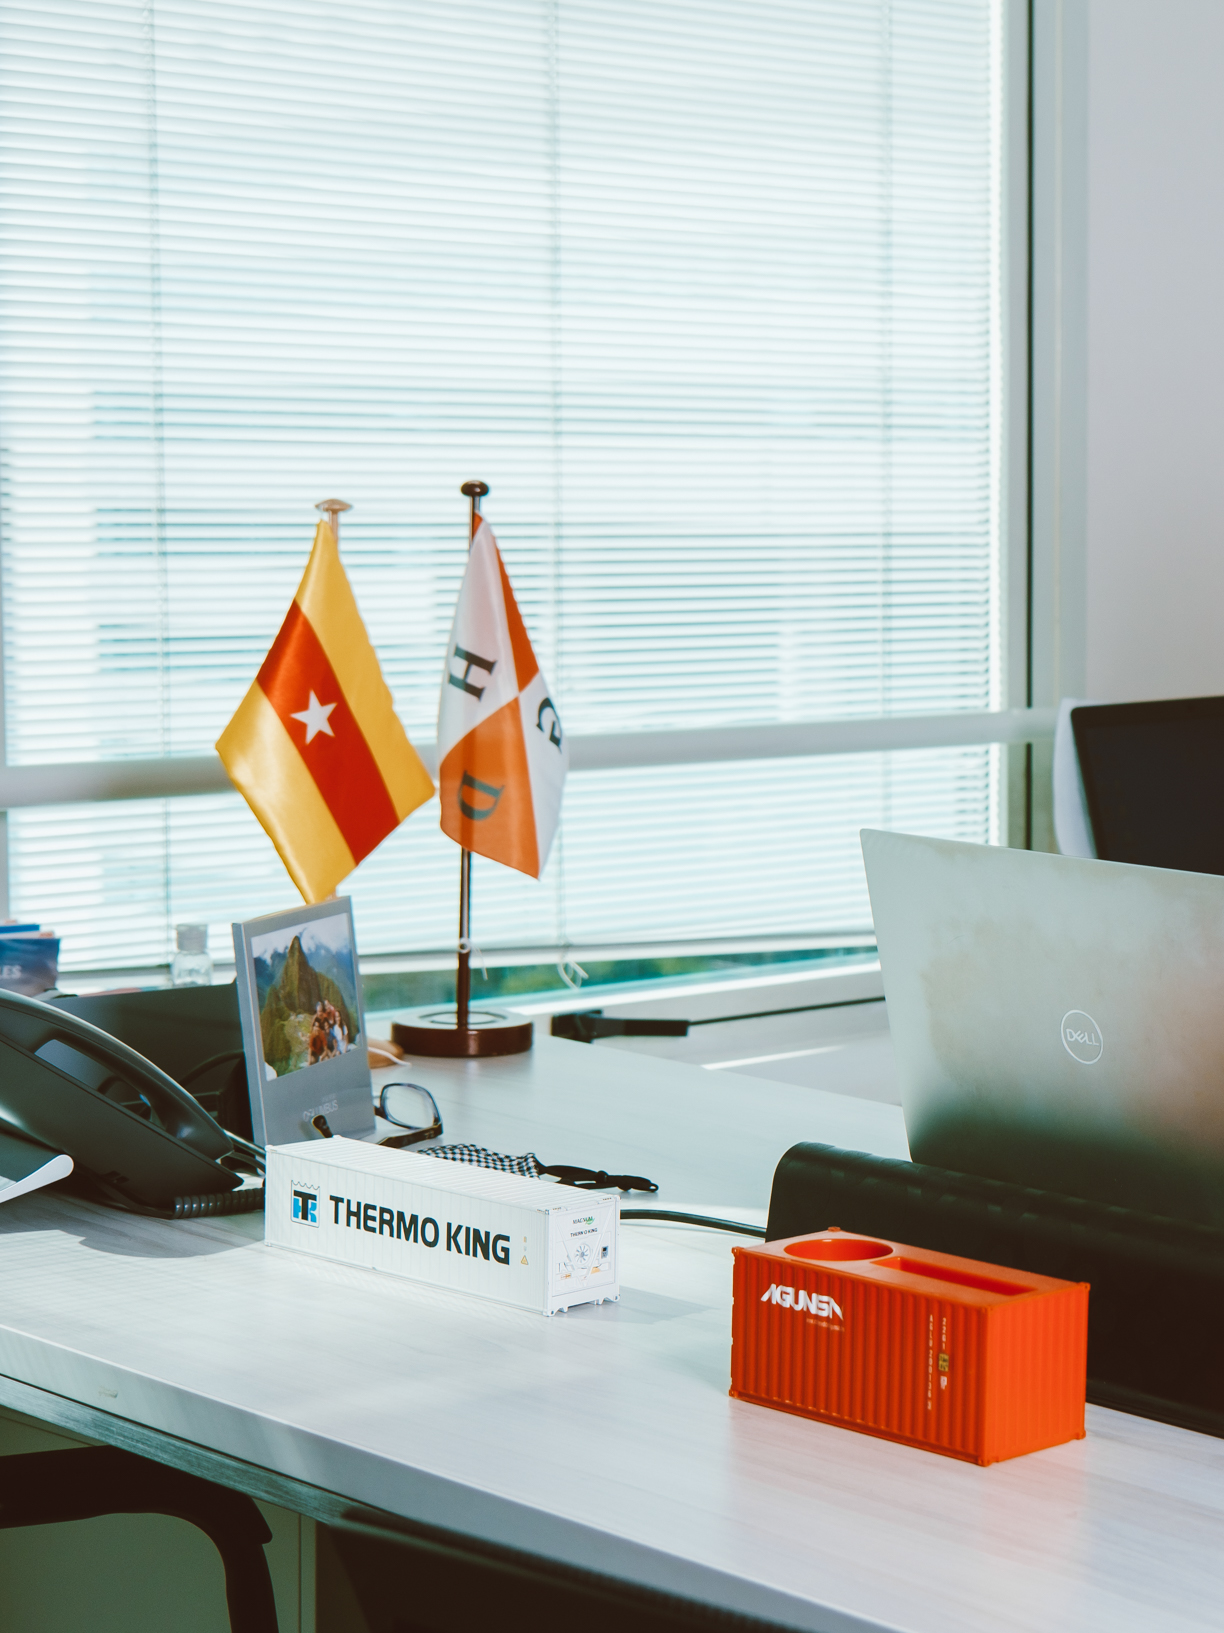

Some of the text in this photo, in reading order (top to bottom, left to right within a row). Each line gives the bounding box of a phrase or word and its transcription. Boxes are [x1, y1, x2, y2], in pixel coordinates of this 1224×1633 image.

[447, 642, 499, 703] H
[1065, 1028, 1100, 1046] DELL
[329, 1194, 511, 1266] THERMO KING
[760, 1283, 844, 1321] AGUNSA
